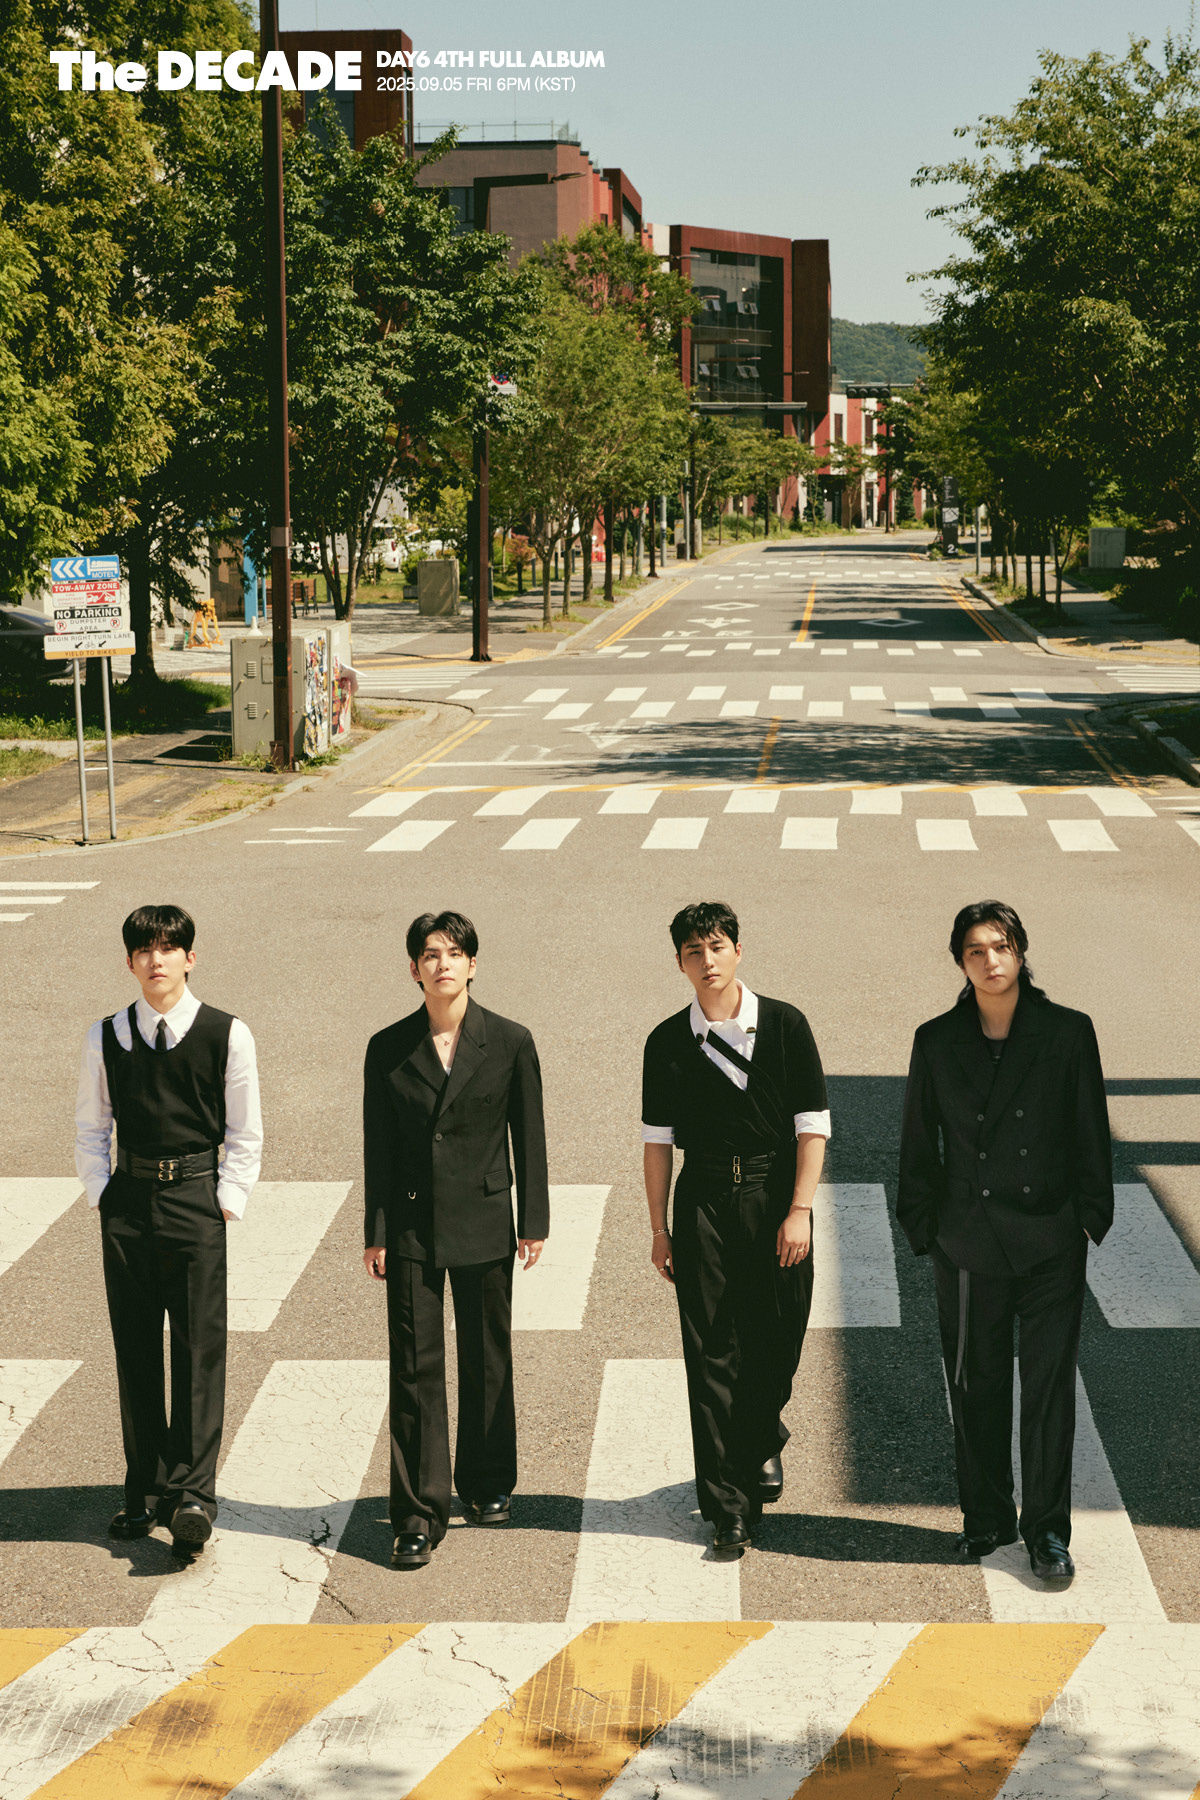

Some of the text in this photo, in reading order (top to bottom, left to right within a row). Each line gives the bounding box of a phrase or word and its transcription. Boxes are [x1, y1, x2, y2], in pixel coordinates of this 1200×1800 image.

[54, 582, 118, 592] TOW-AWAY ZONE
[56, 608, 120, 619] NO PARKING
[69, 617, 107, 625] DUMPSTER
